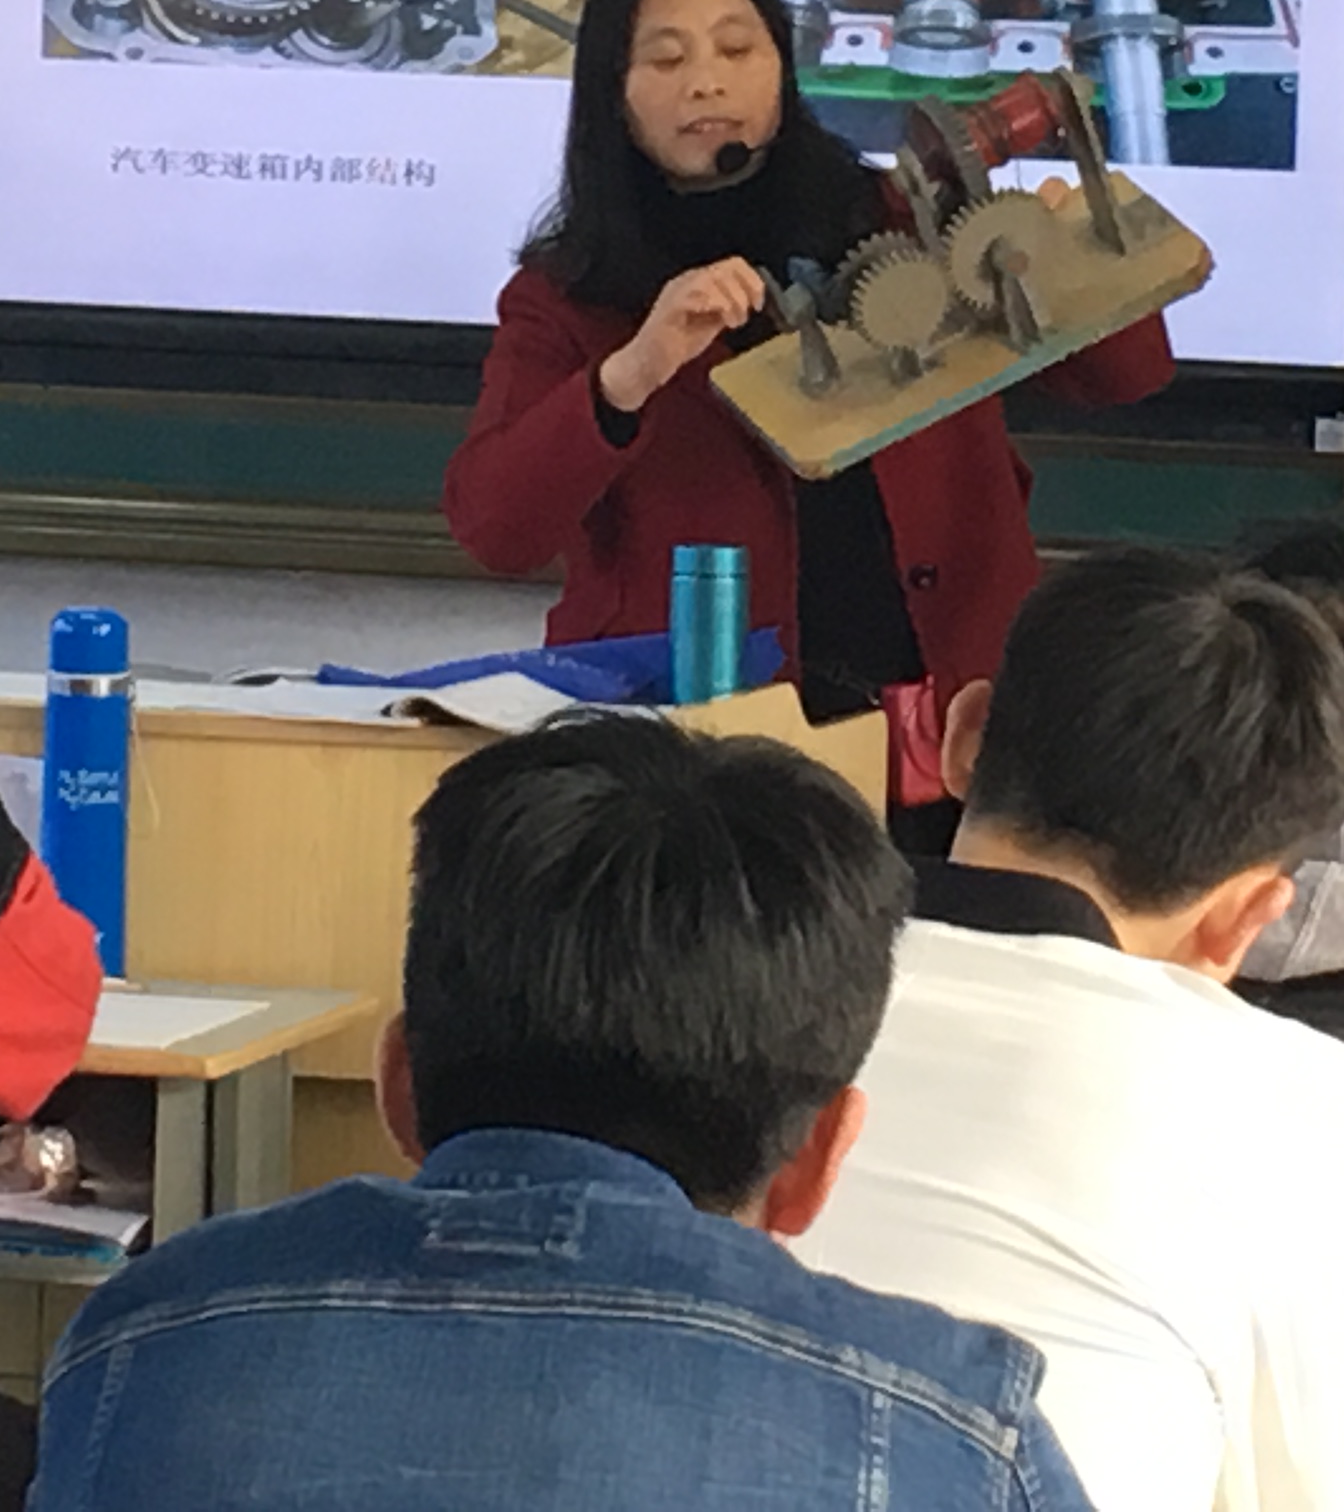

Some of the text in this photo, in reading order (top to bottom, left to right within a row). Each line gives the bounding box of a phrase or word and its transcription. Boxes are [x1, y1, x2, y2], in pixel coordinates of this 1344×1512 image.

[110, 146, 437, 187] 汽车变速箱内部结构
